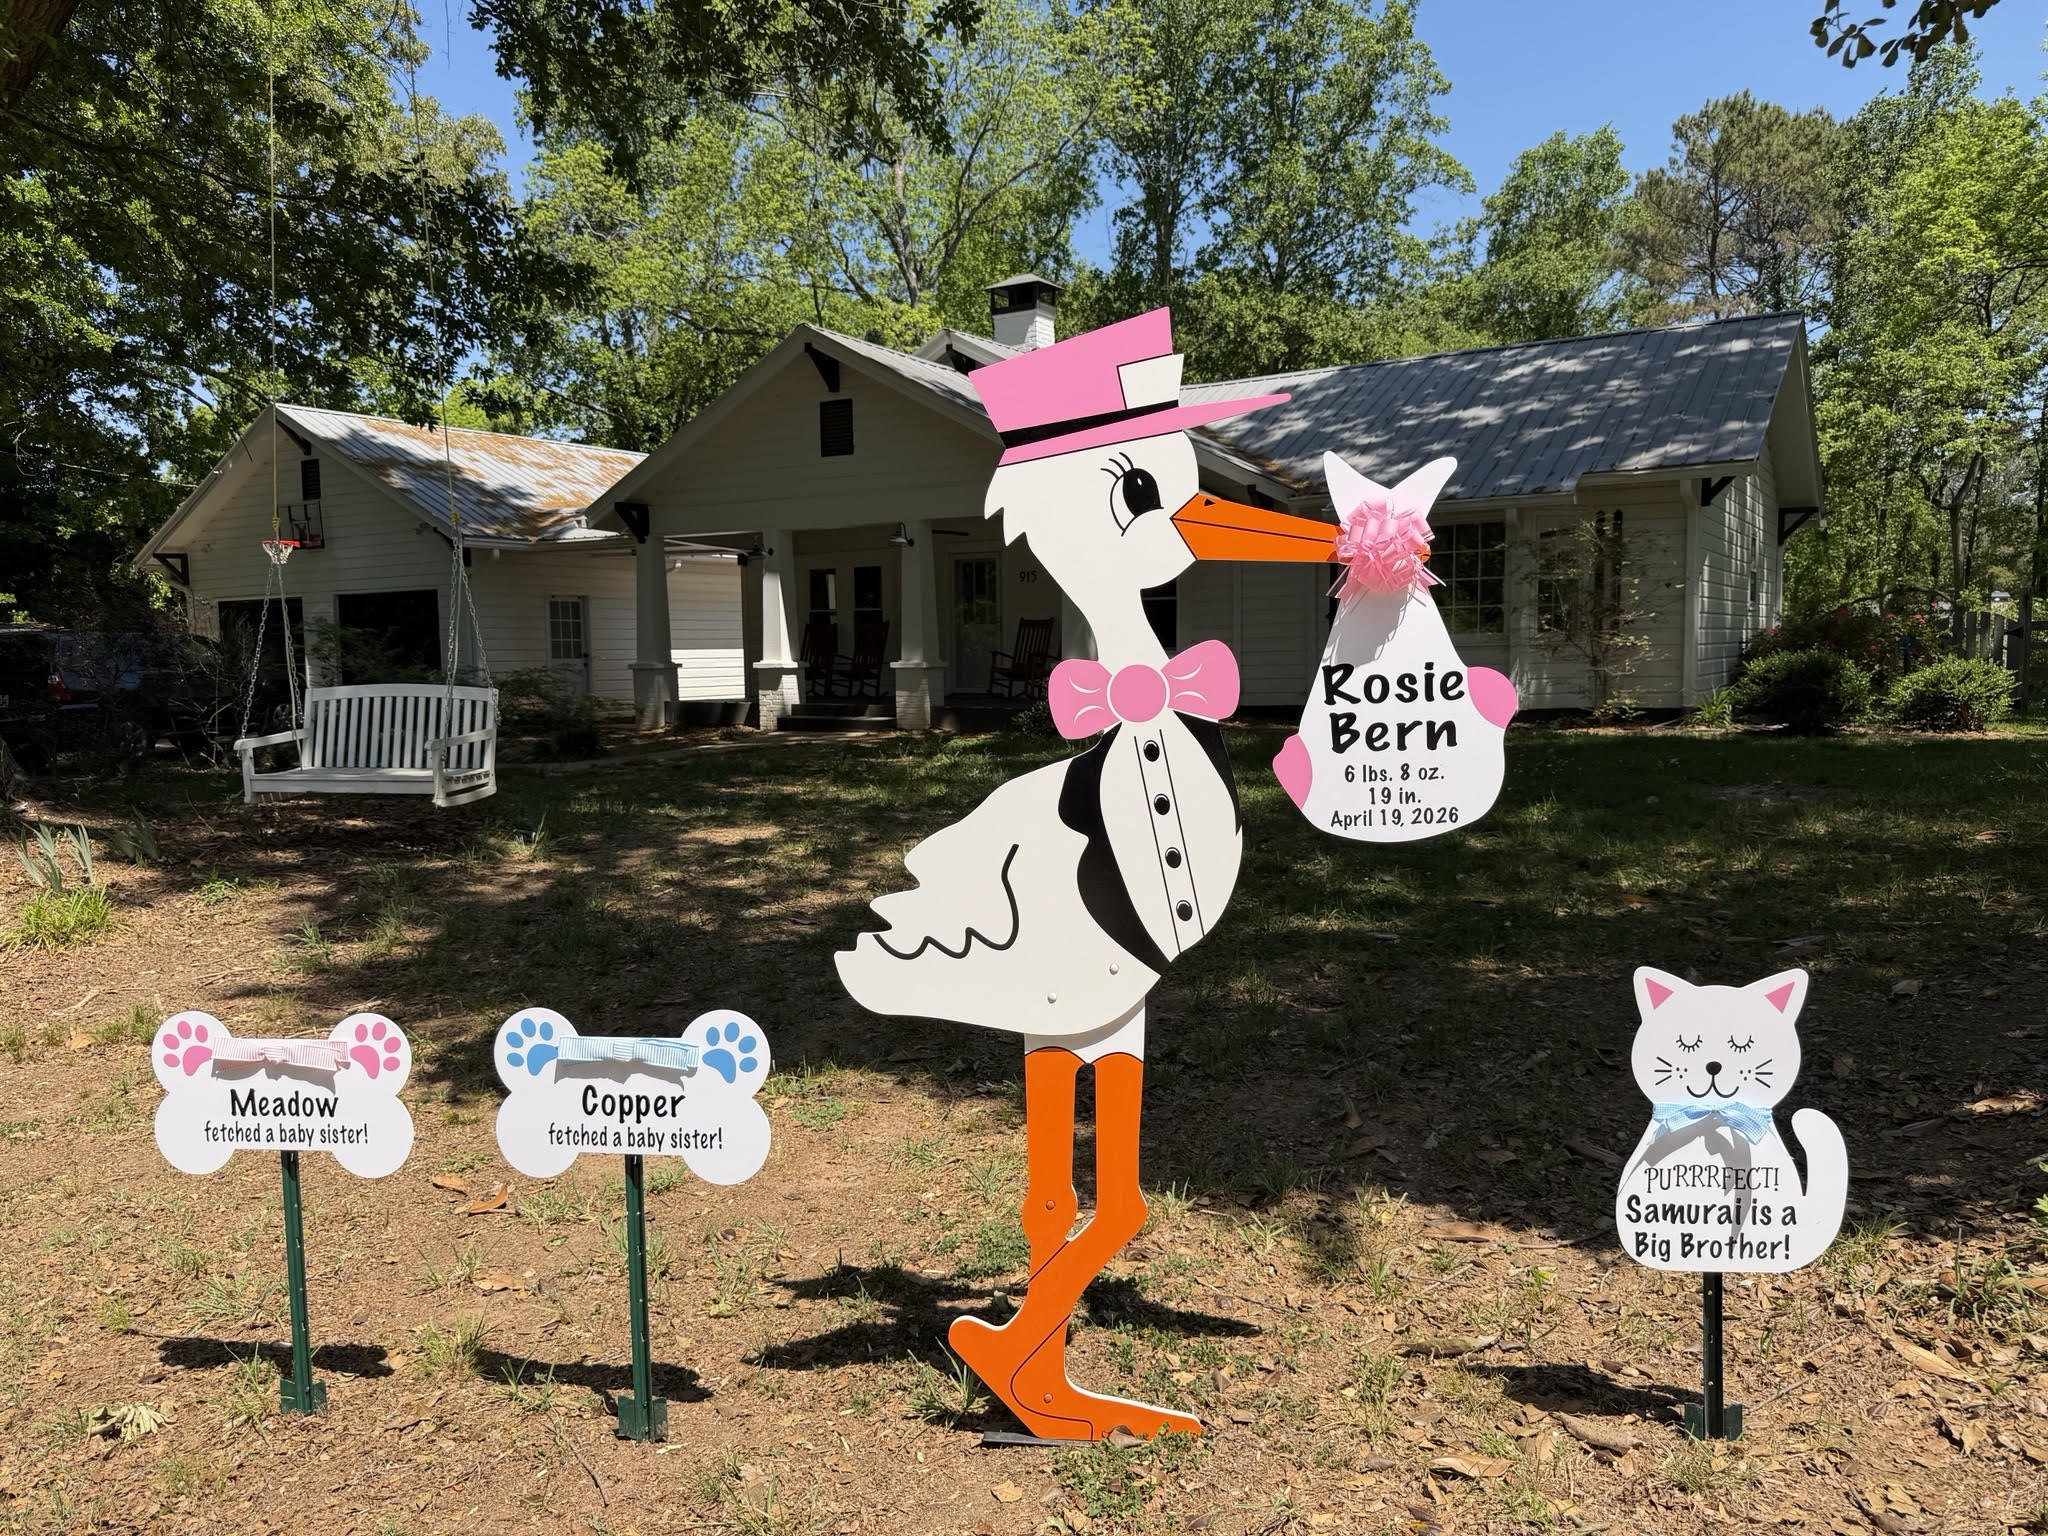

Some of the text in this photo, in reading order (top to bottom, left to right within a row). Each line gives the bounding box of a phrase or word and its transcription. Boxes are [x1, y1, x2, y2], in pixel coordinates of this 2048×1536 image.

[1019, 570, 1037, 583] 915
[1321, 661, 1465, 706] Rosie
[1329, 711, 1458, 754] Bern
[1344, 762, 1444, 783] 6 lbs. 8 oz.
[1369, 786, 1421, 805] 19 in.
[1330, 806, 1459, 831] April 19, 2026
[230, 1088, 339, 1118] Meadow
[582, 1084, 686, 1123] Copper
[204, 1120, 368, 1147] fetched a baby sister!
[548, 1122, 722, 1153] fetched a baby sister!
[1644, 1164, 1779, 1193] PURRRFECT!
[1625, 1194, 1797, 1226] Samurai is a
[1634, 1231, 1790, 1262] Big Brother!
